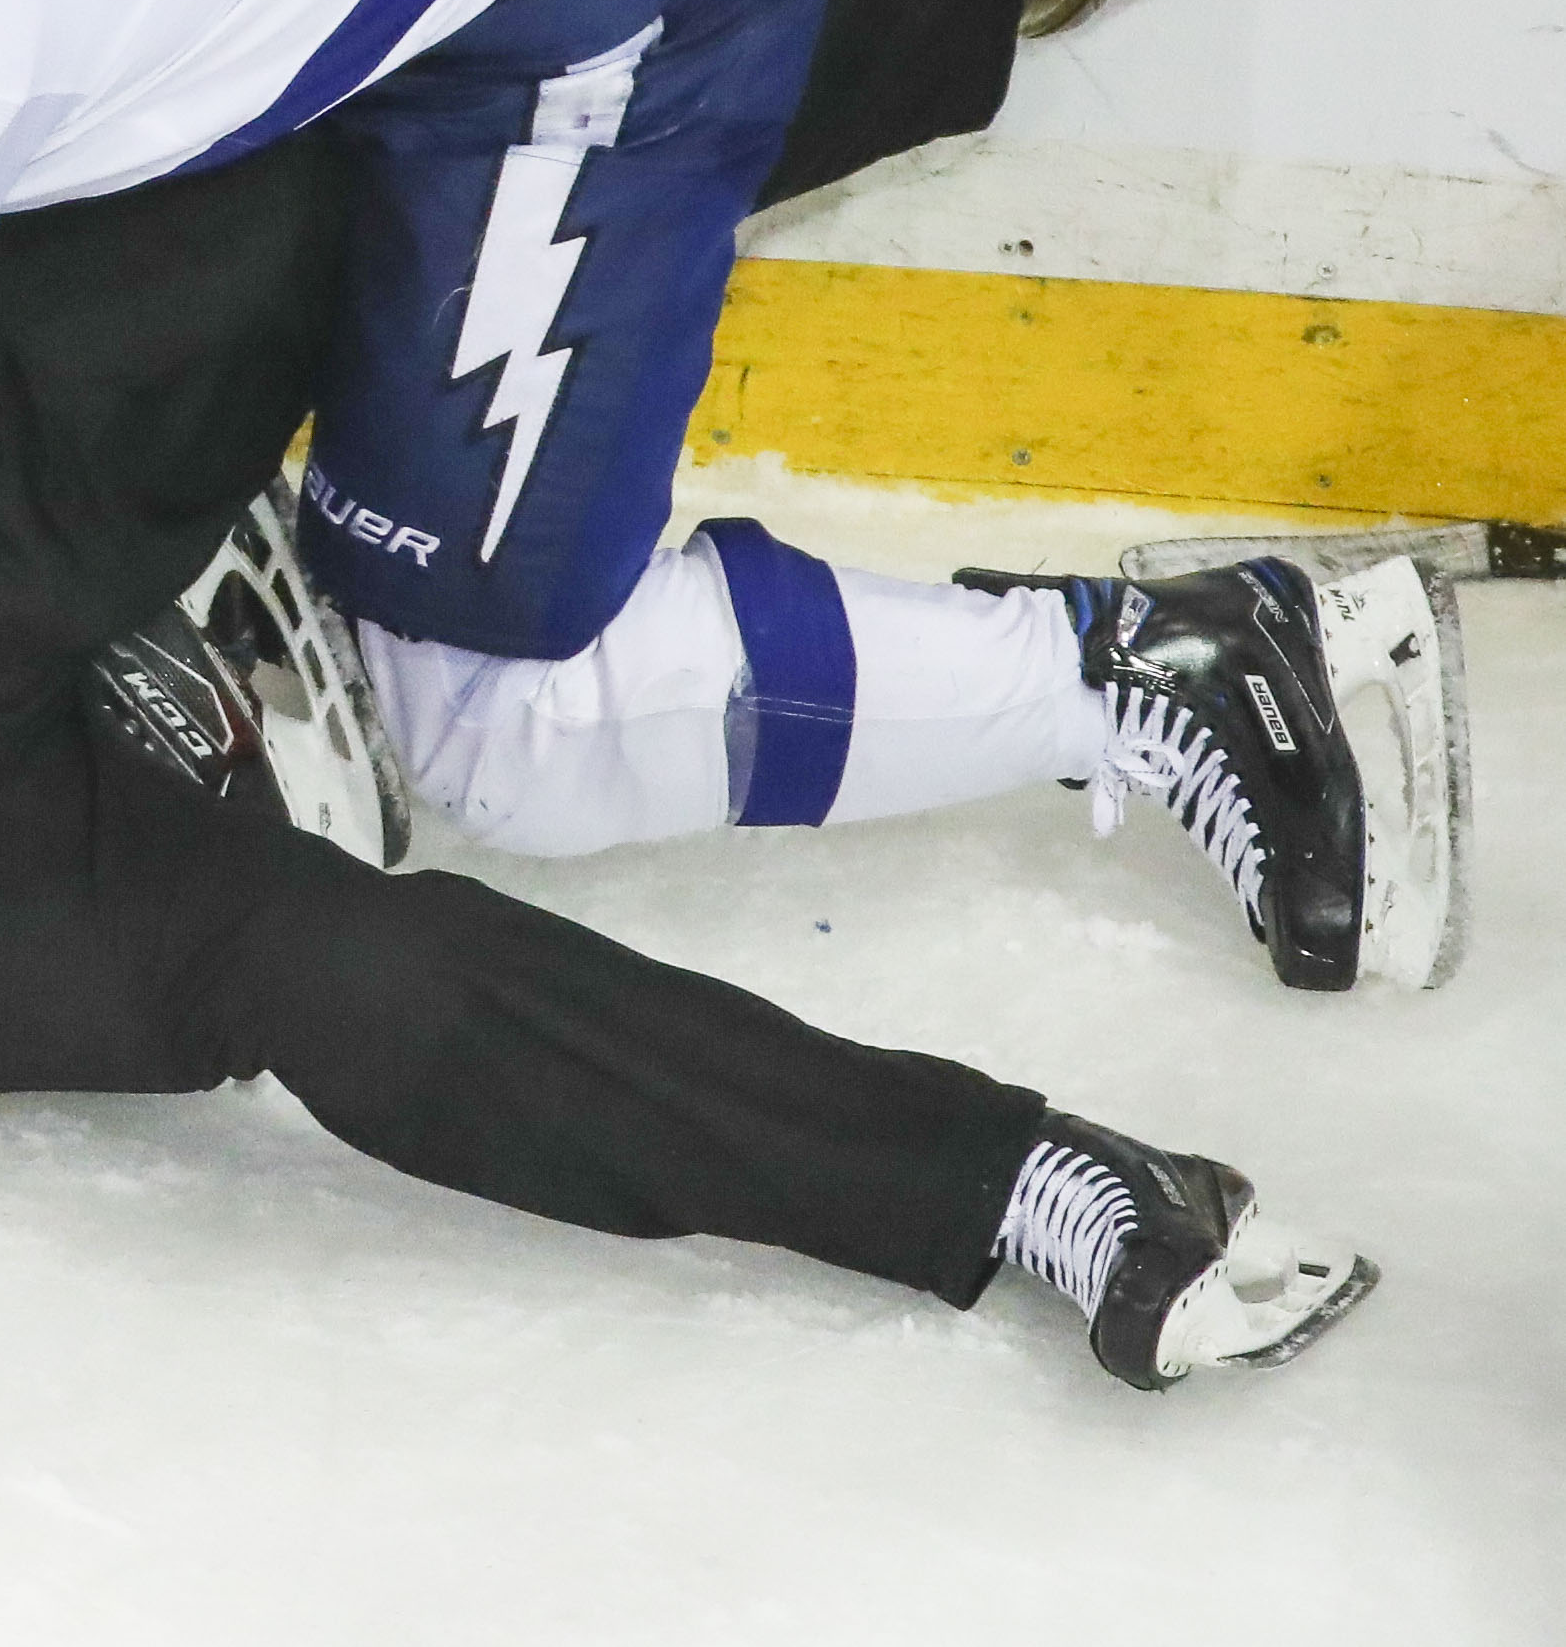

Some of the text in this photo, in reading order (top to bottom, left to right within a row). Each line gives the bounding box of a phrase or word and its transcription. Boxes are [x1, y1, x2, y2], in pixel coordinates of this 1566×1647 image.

[306, 463, 441, 568] AUER
[122, 672, 213, 760] CCM
[1255, 680, 1290, 745] BAUER
